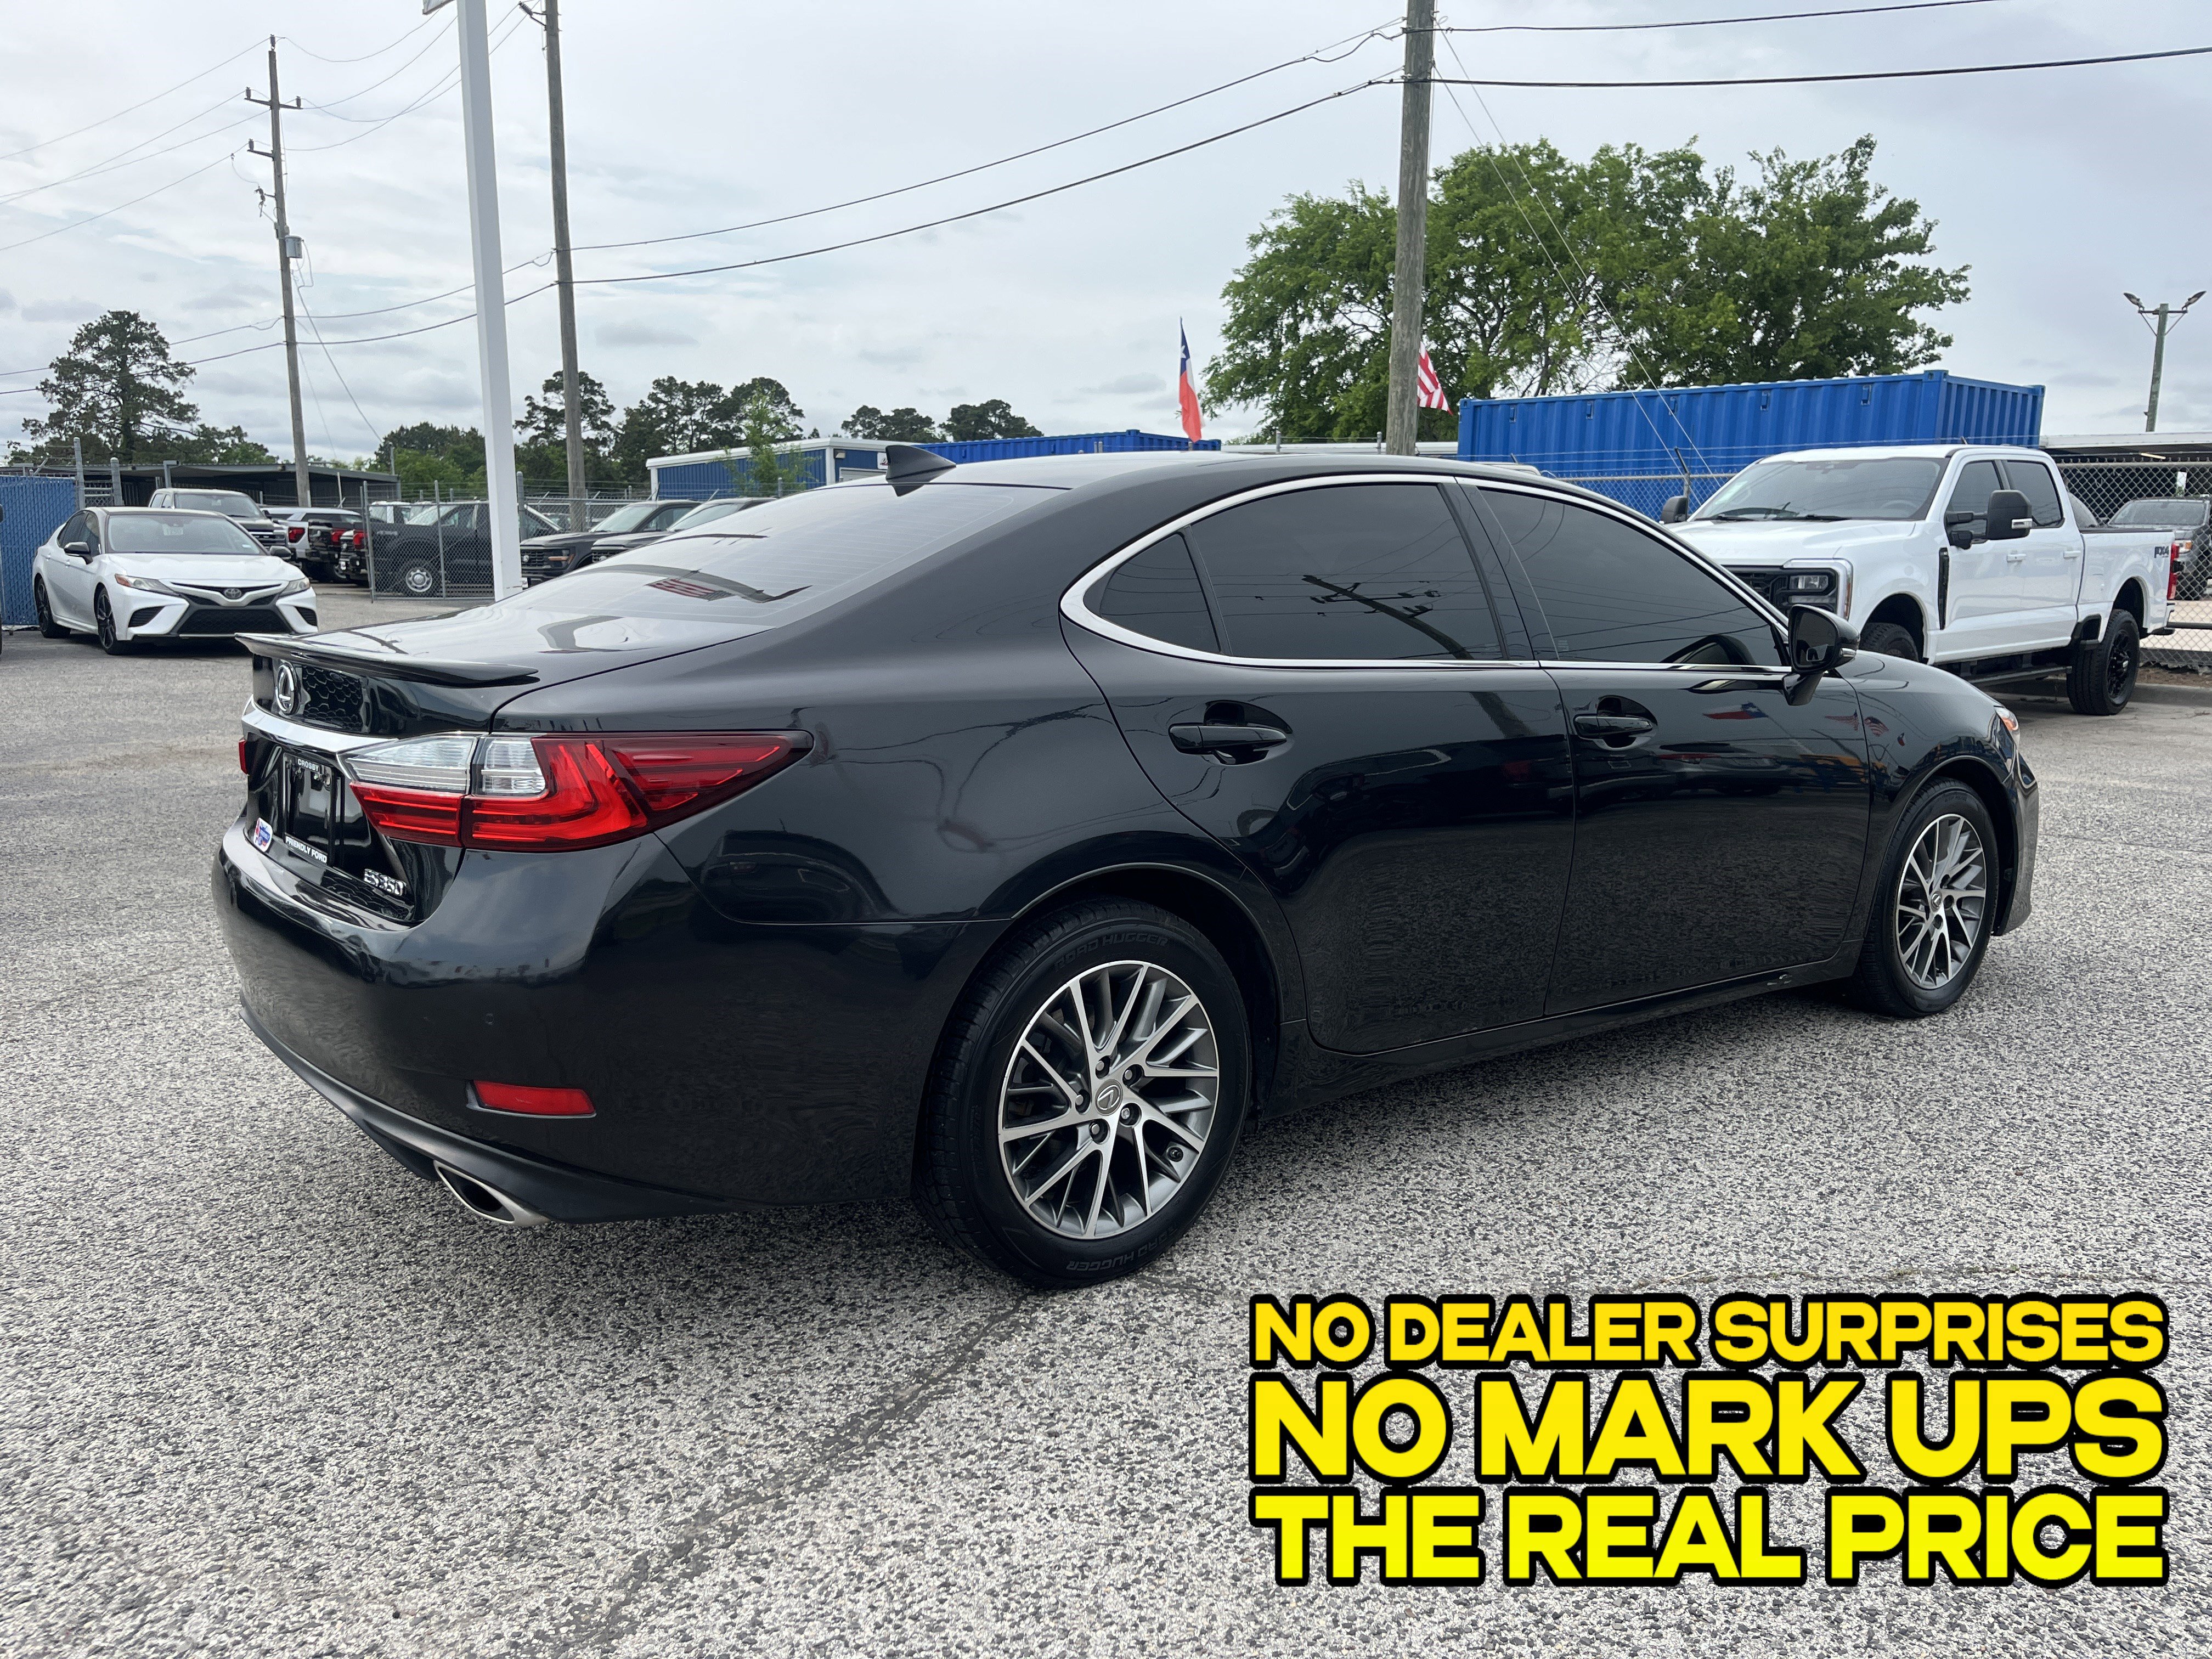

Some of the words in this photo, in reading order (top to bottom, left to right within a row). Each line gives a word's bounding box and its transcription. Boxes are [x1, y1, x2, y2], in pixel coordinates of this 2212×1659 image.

[297, 758, 319, 772] CROSBY
[285, 835, 311, 855] FRIENDLY
[311, 848, 328, 864] FORD
[1101, 933, 1168, 946] HUGGER
